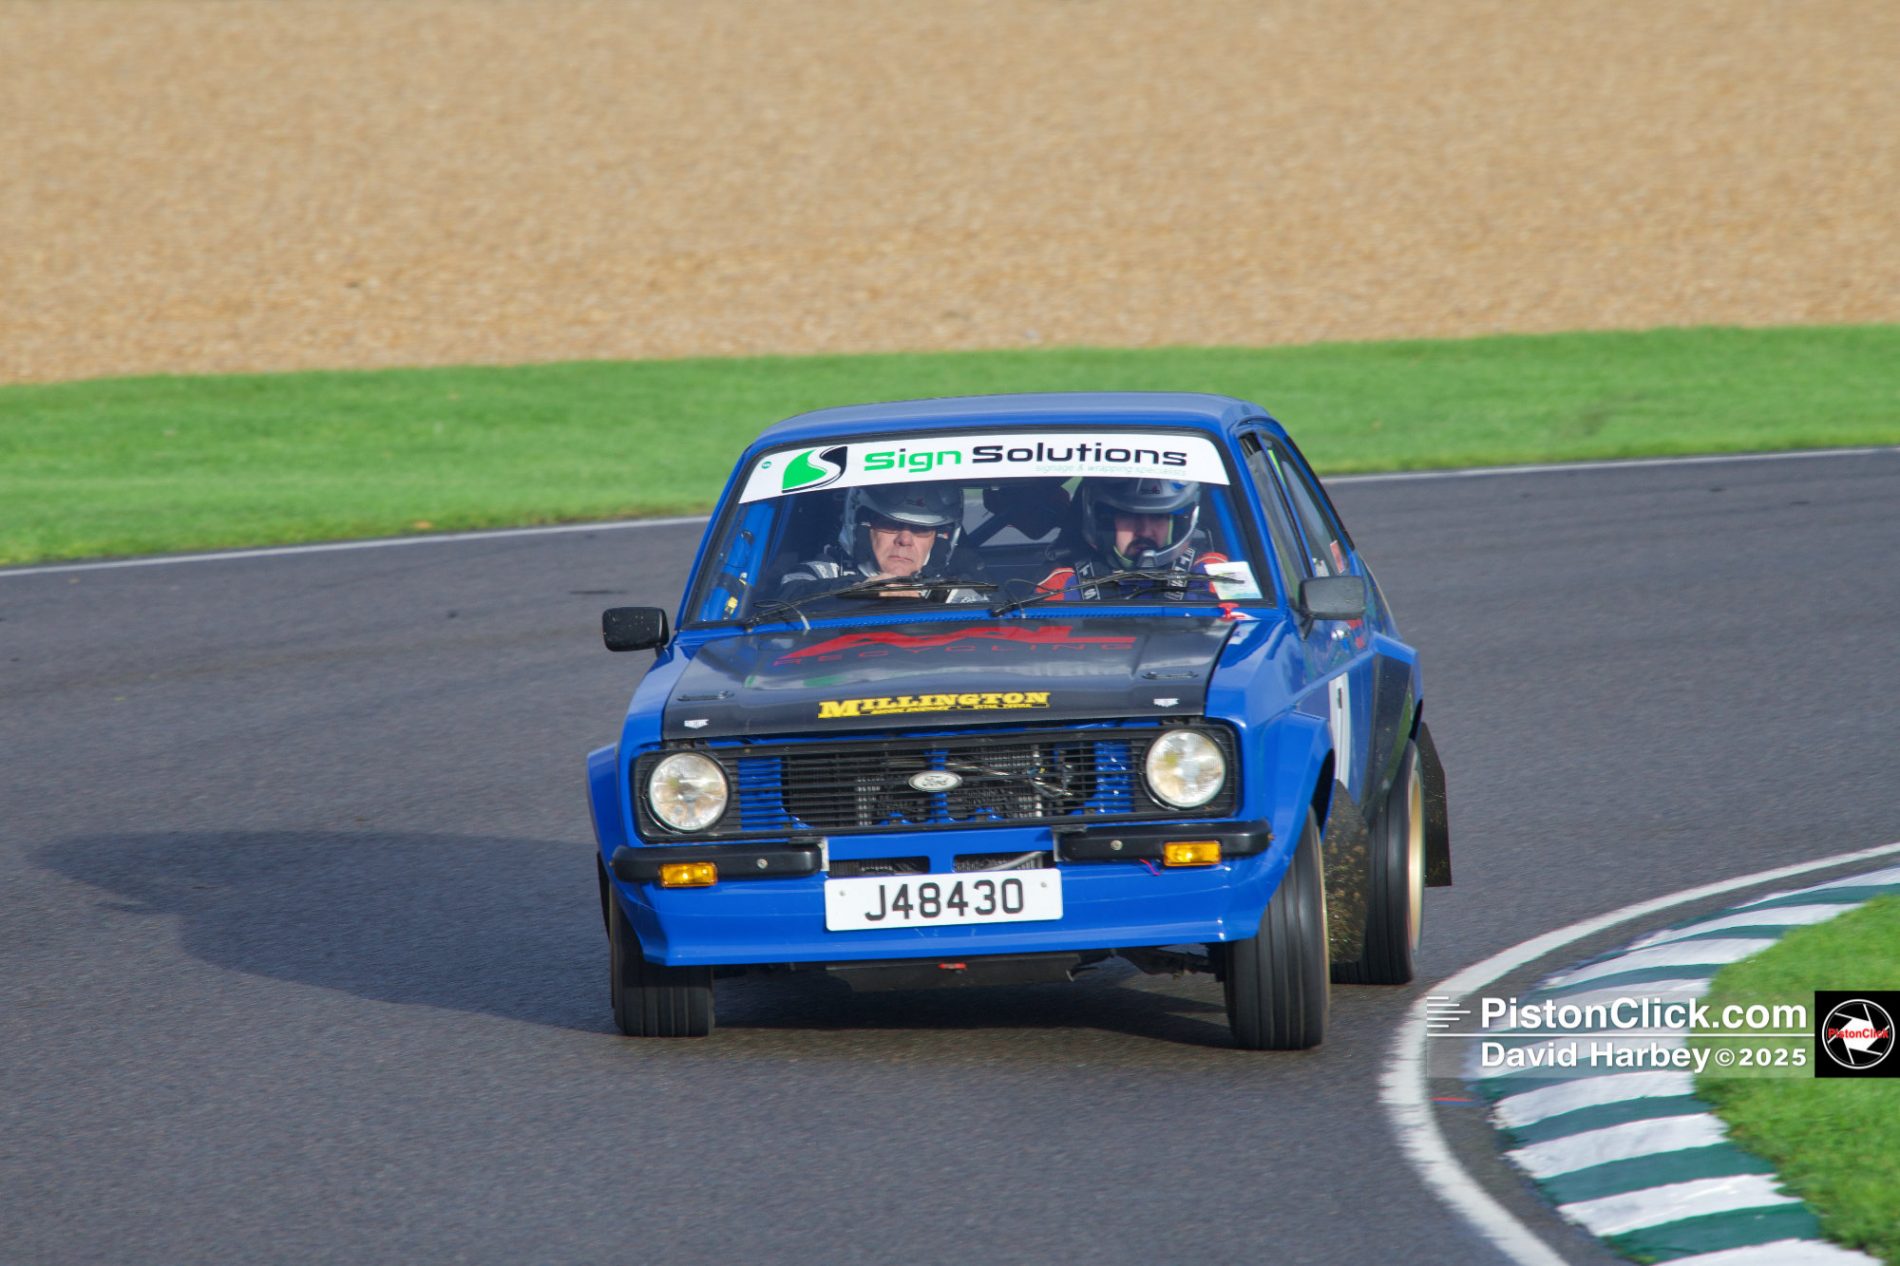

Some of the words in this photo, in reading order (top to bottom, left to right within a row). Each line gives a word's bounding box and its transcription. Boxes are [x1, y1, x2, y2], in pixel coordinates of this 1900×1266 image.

[864, 448, 962, 473] Sign
[971, 442, 1187, 467] Solutions
[817, 692, 1051, 719] MILLINGTON
[864, 877, 1024, 922] J48430
